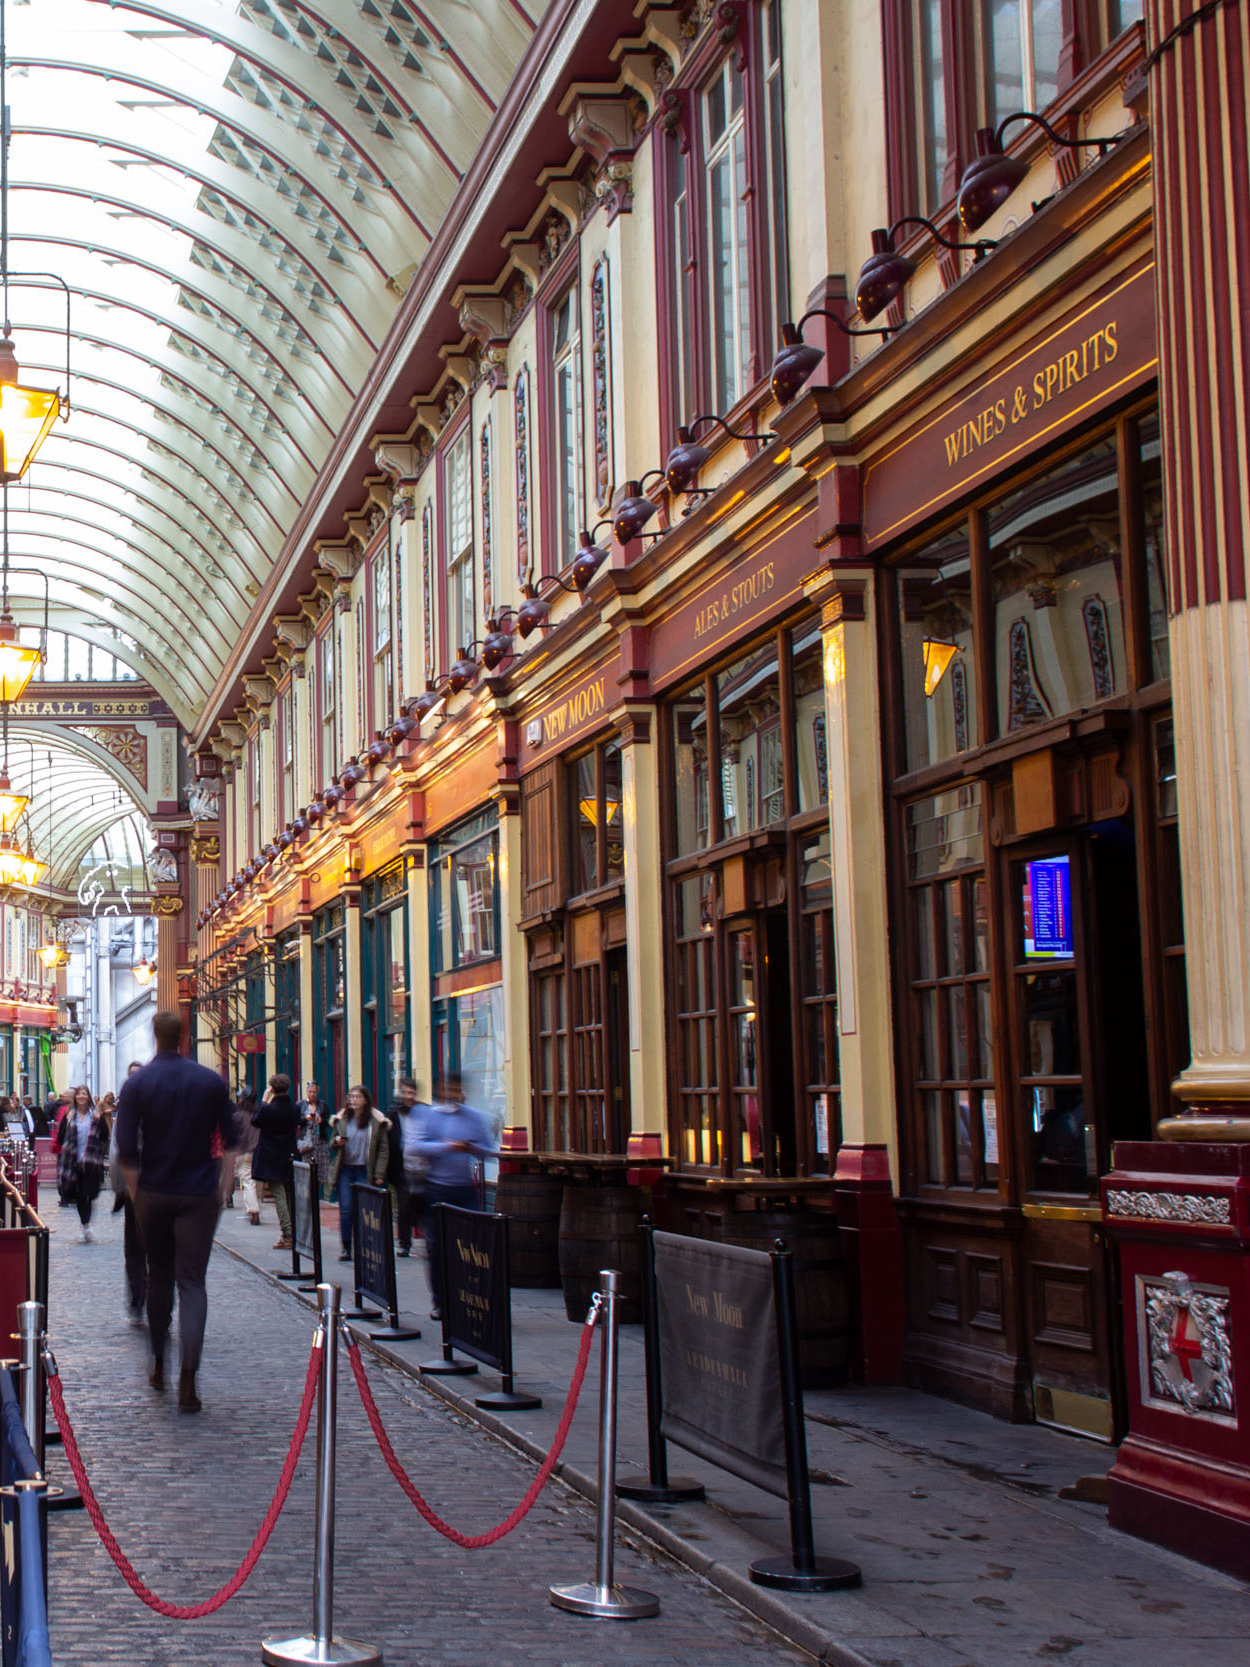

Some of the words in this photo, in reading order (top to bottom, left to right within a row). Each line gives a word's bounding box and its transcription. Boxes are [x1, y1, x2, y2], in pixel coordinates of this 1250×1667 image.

[943, 398, 1006, 467] WINES
[1010, 385, 1028, 425] &
[1033, 320, 1119, 410] SPIRITS
[693, 600, 719, 640] ALES
[720, 593, 730, 620] &
[731, 561, 775, 613] STOUTS
[542, 702, 568, 745] NEW
[568, 677, 605, 729] MOON
[686, 1283, 711, 1316] New
[713, 1290, 743, 1329] Moon
